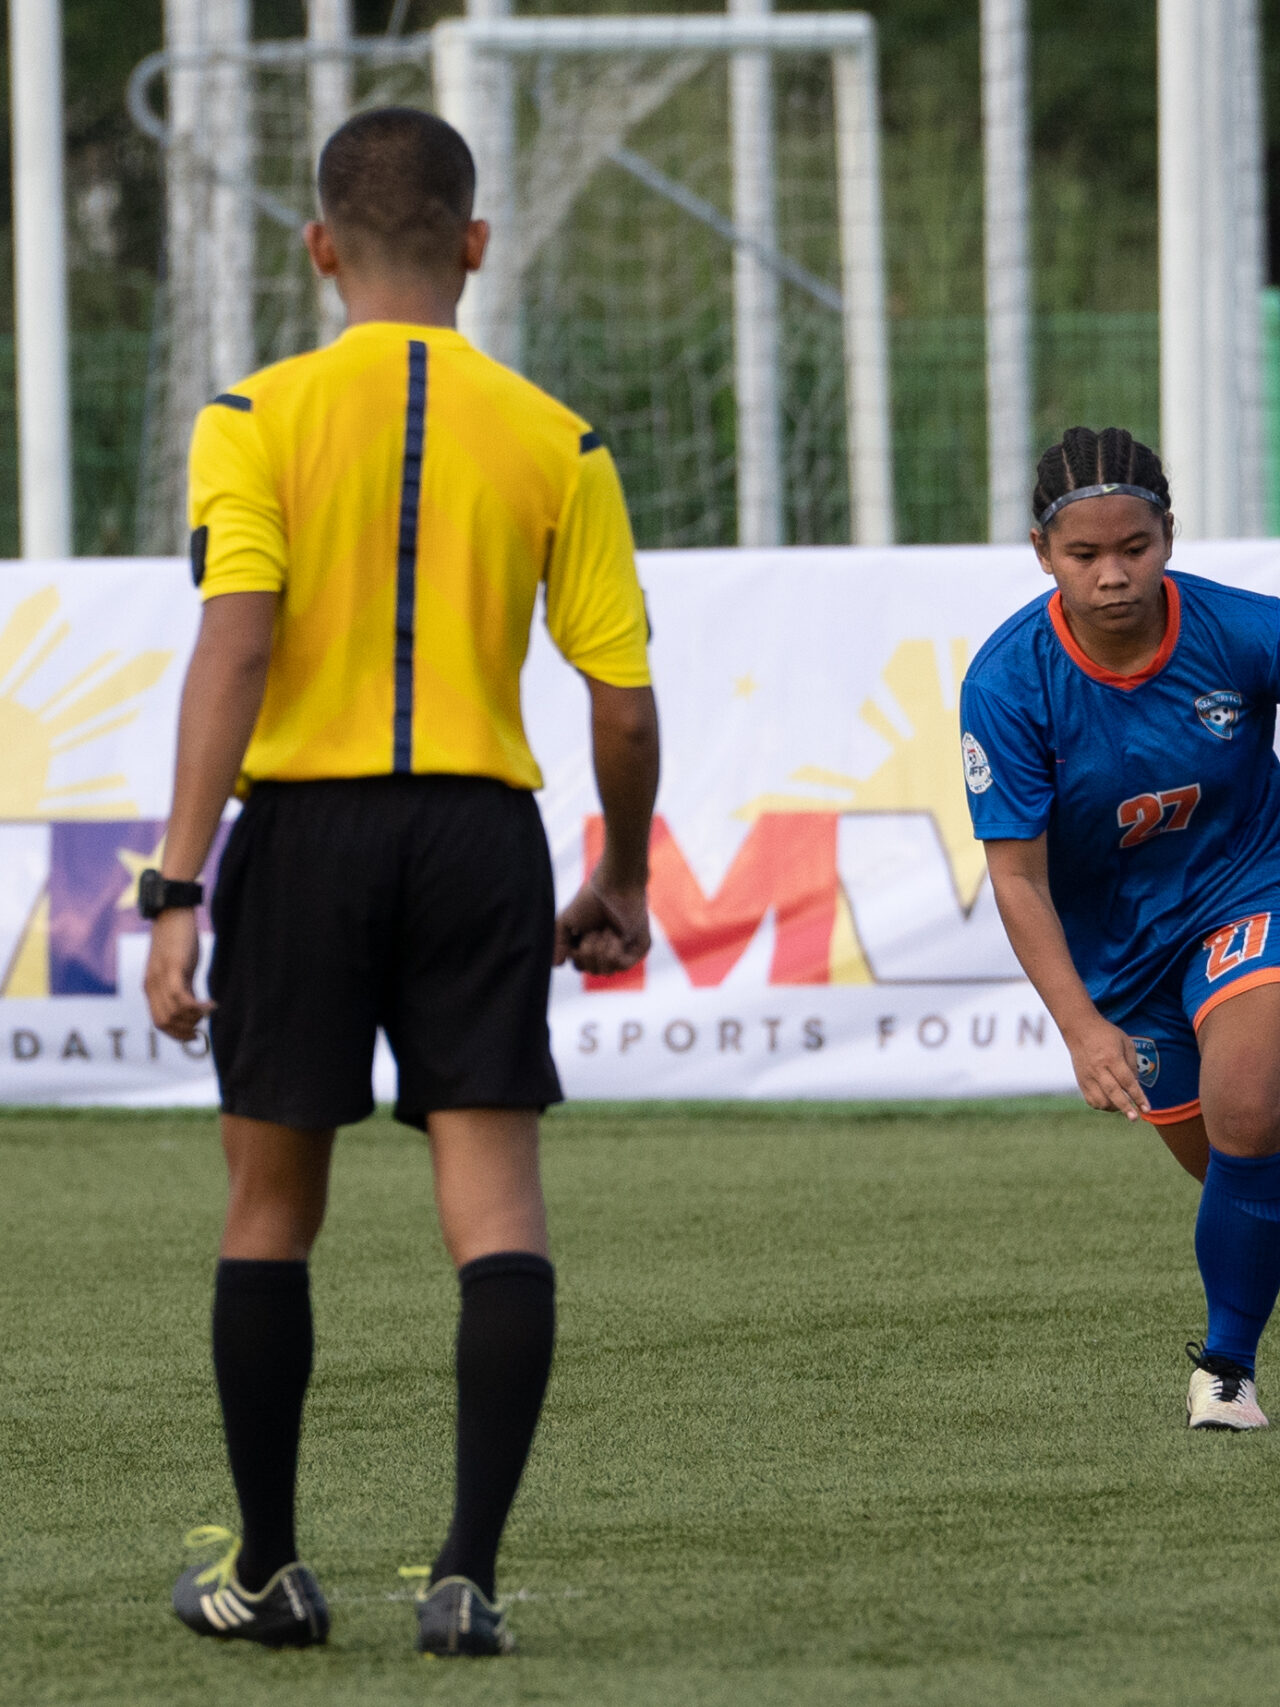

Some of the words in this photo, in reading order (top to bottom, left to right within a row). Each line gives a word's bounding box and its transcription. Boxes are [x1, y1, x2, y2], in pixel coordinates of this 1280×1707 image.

[1117, 782, 1201, 848] 27
[578, 1017, 826, 1054] SPORTS
[876, 1014, 1047, 1050] FOUN
